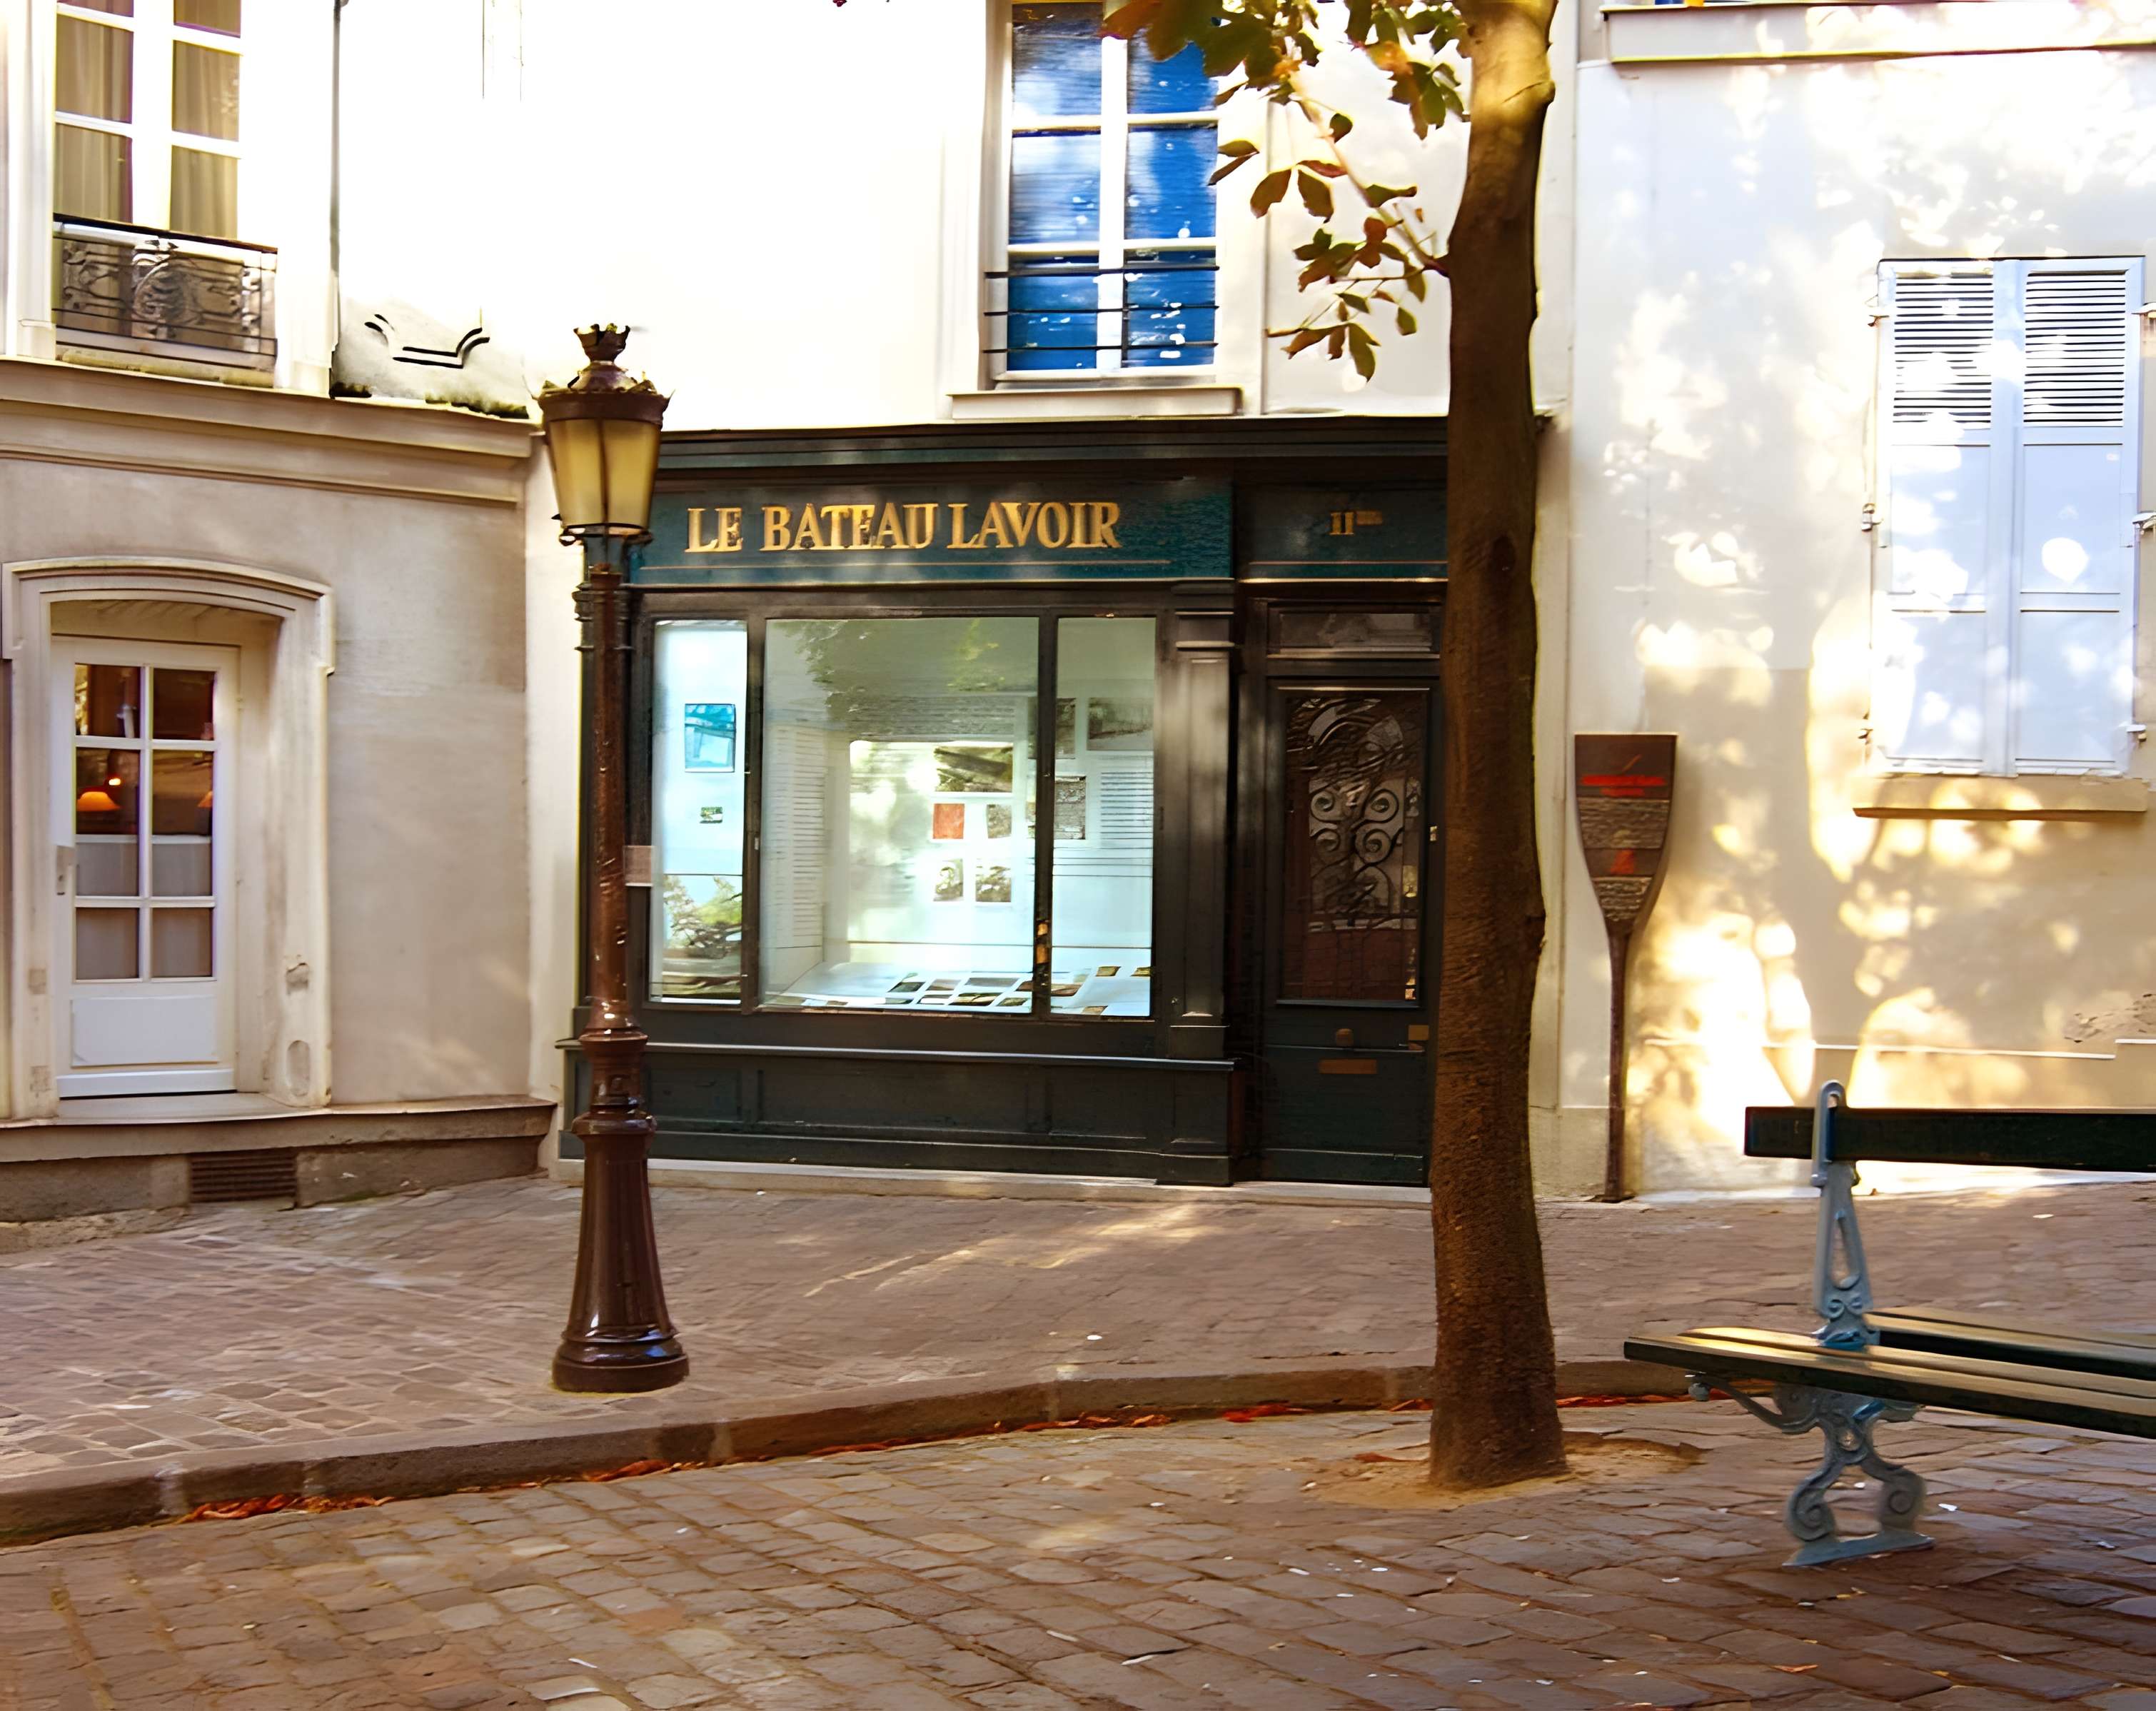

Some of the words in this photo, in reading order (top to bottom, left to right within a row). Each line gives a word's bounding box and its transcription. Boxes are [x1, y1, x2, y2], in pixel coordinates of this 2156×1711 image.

[685, 507, 743, 553] LE
[760, 503, 939, 551] BATEAU
[947, 502, 1121, 549] LAVOIR
